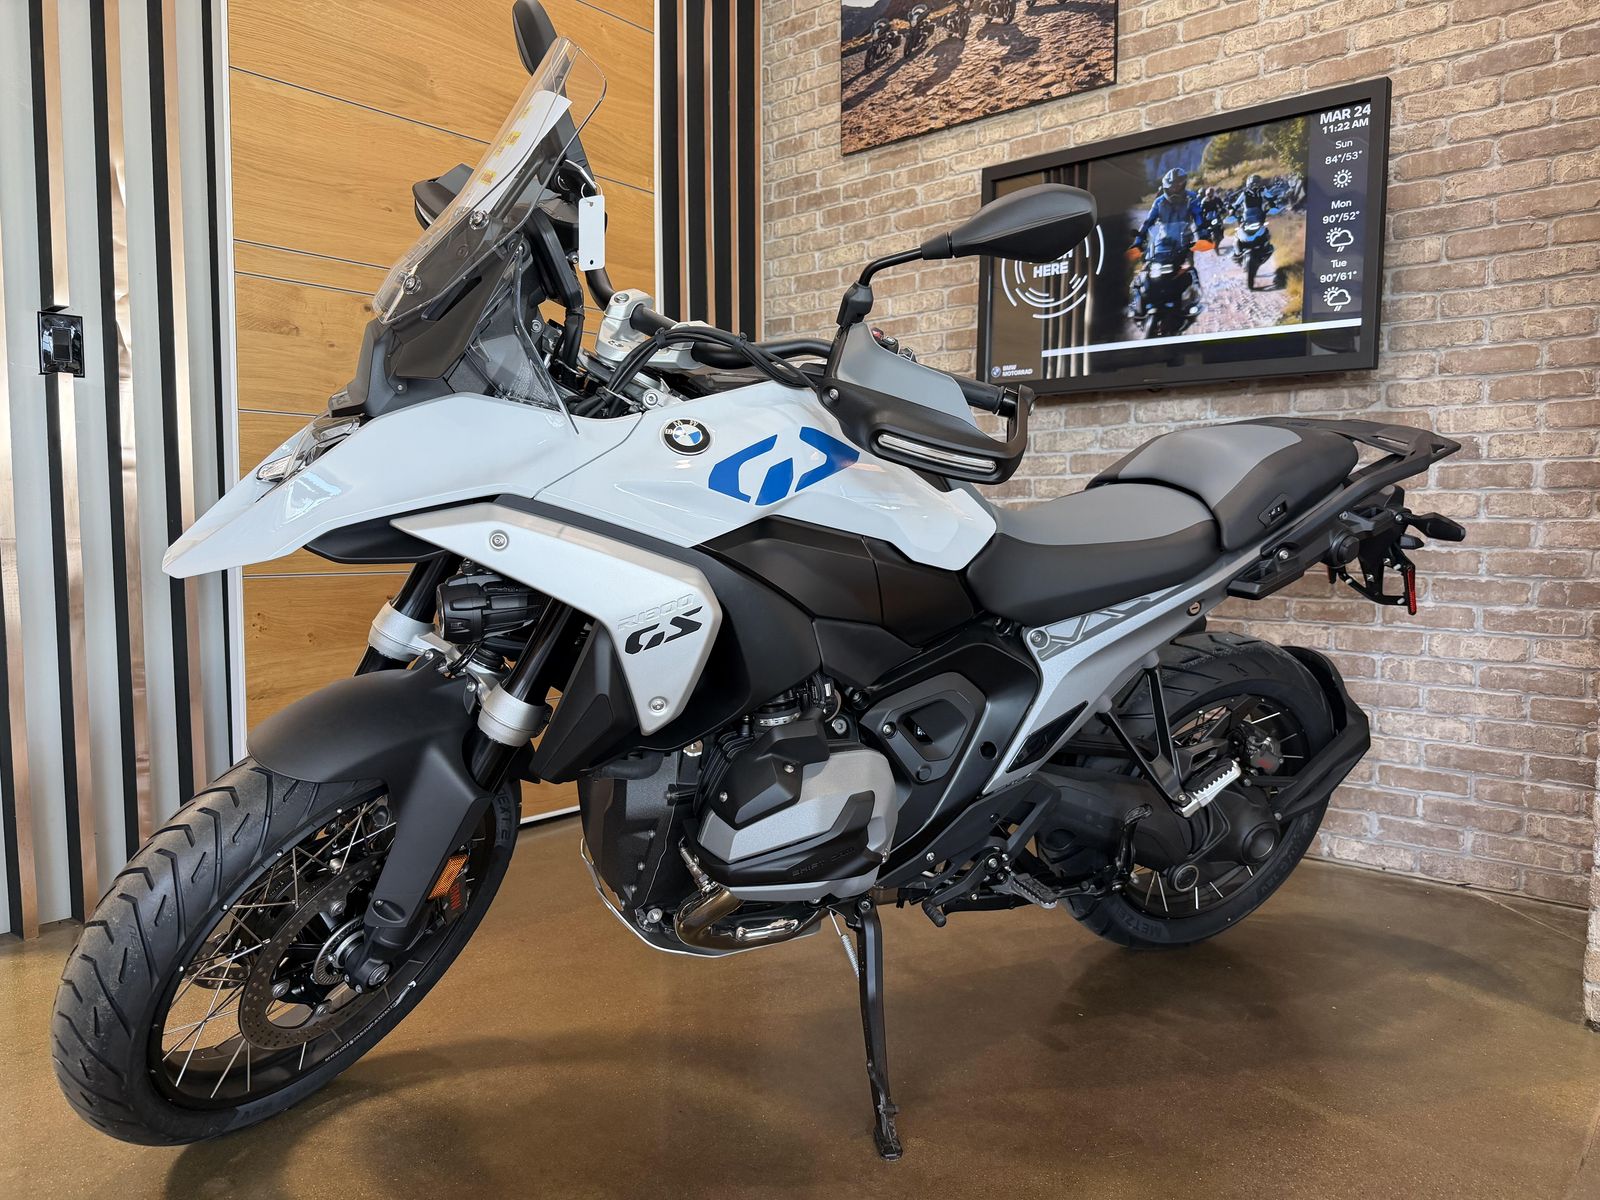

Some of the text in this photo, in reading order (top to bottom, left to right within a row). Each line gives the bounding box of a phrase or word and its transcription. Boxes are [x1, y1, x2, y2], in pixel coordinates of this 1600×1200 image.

[1320, 104, 1372, 125] MAR 24
[1322, 117, 1369, 135] 11:22 AM
[1335, 140, 1353, 149] Sun
[1325, 150, 1363, 165] 84°/53°
[1331, 200, 1352, 210] Mon
[1322, 210, 1360, 224] 90°/52°
[1033, 260, 1069, 278] HERE
[1330, 259, 1348, 269] Tue
[1320, 270, 1358, 283] 90°/61°
[624, 605, 703, 654] GS
